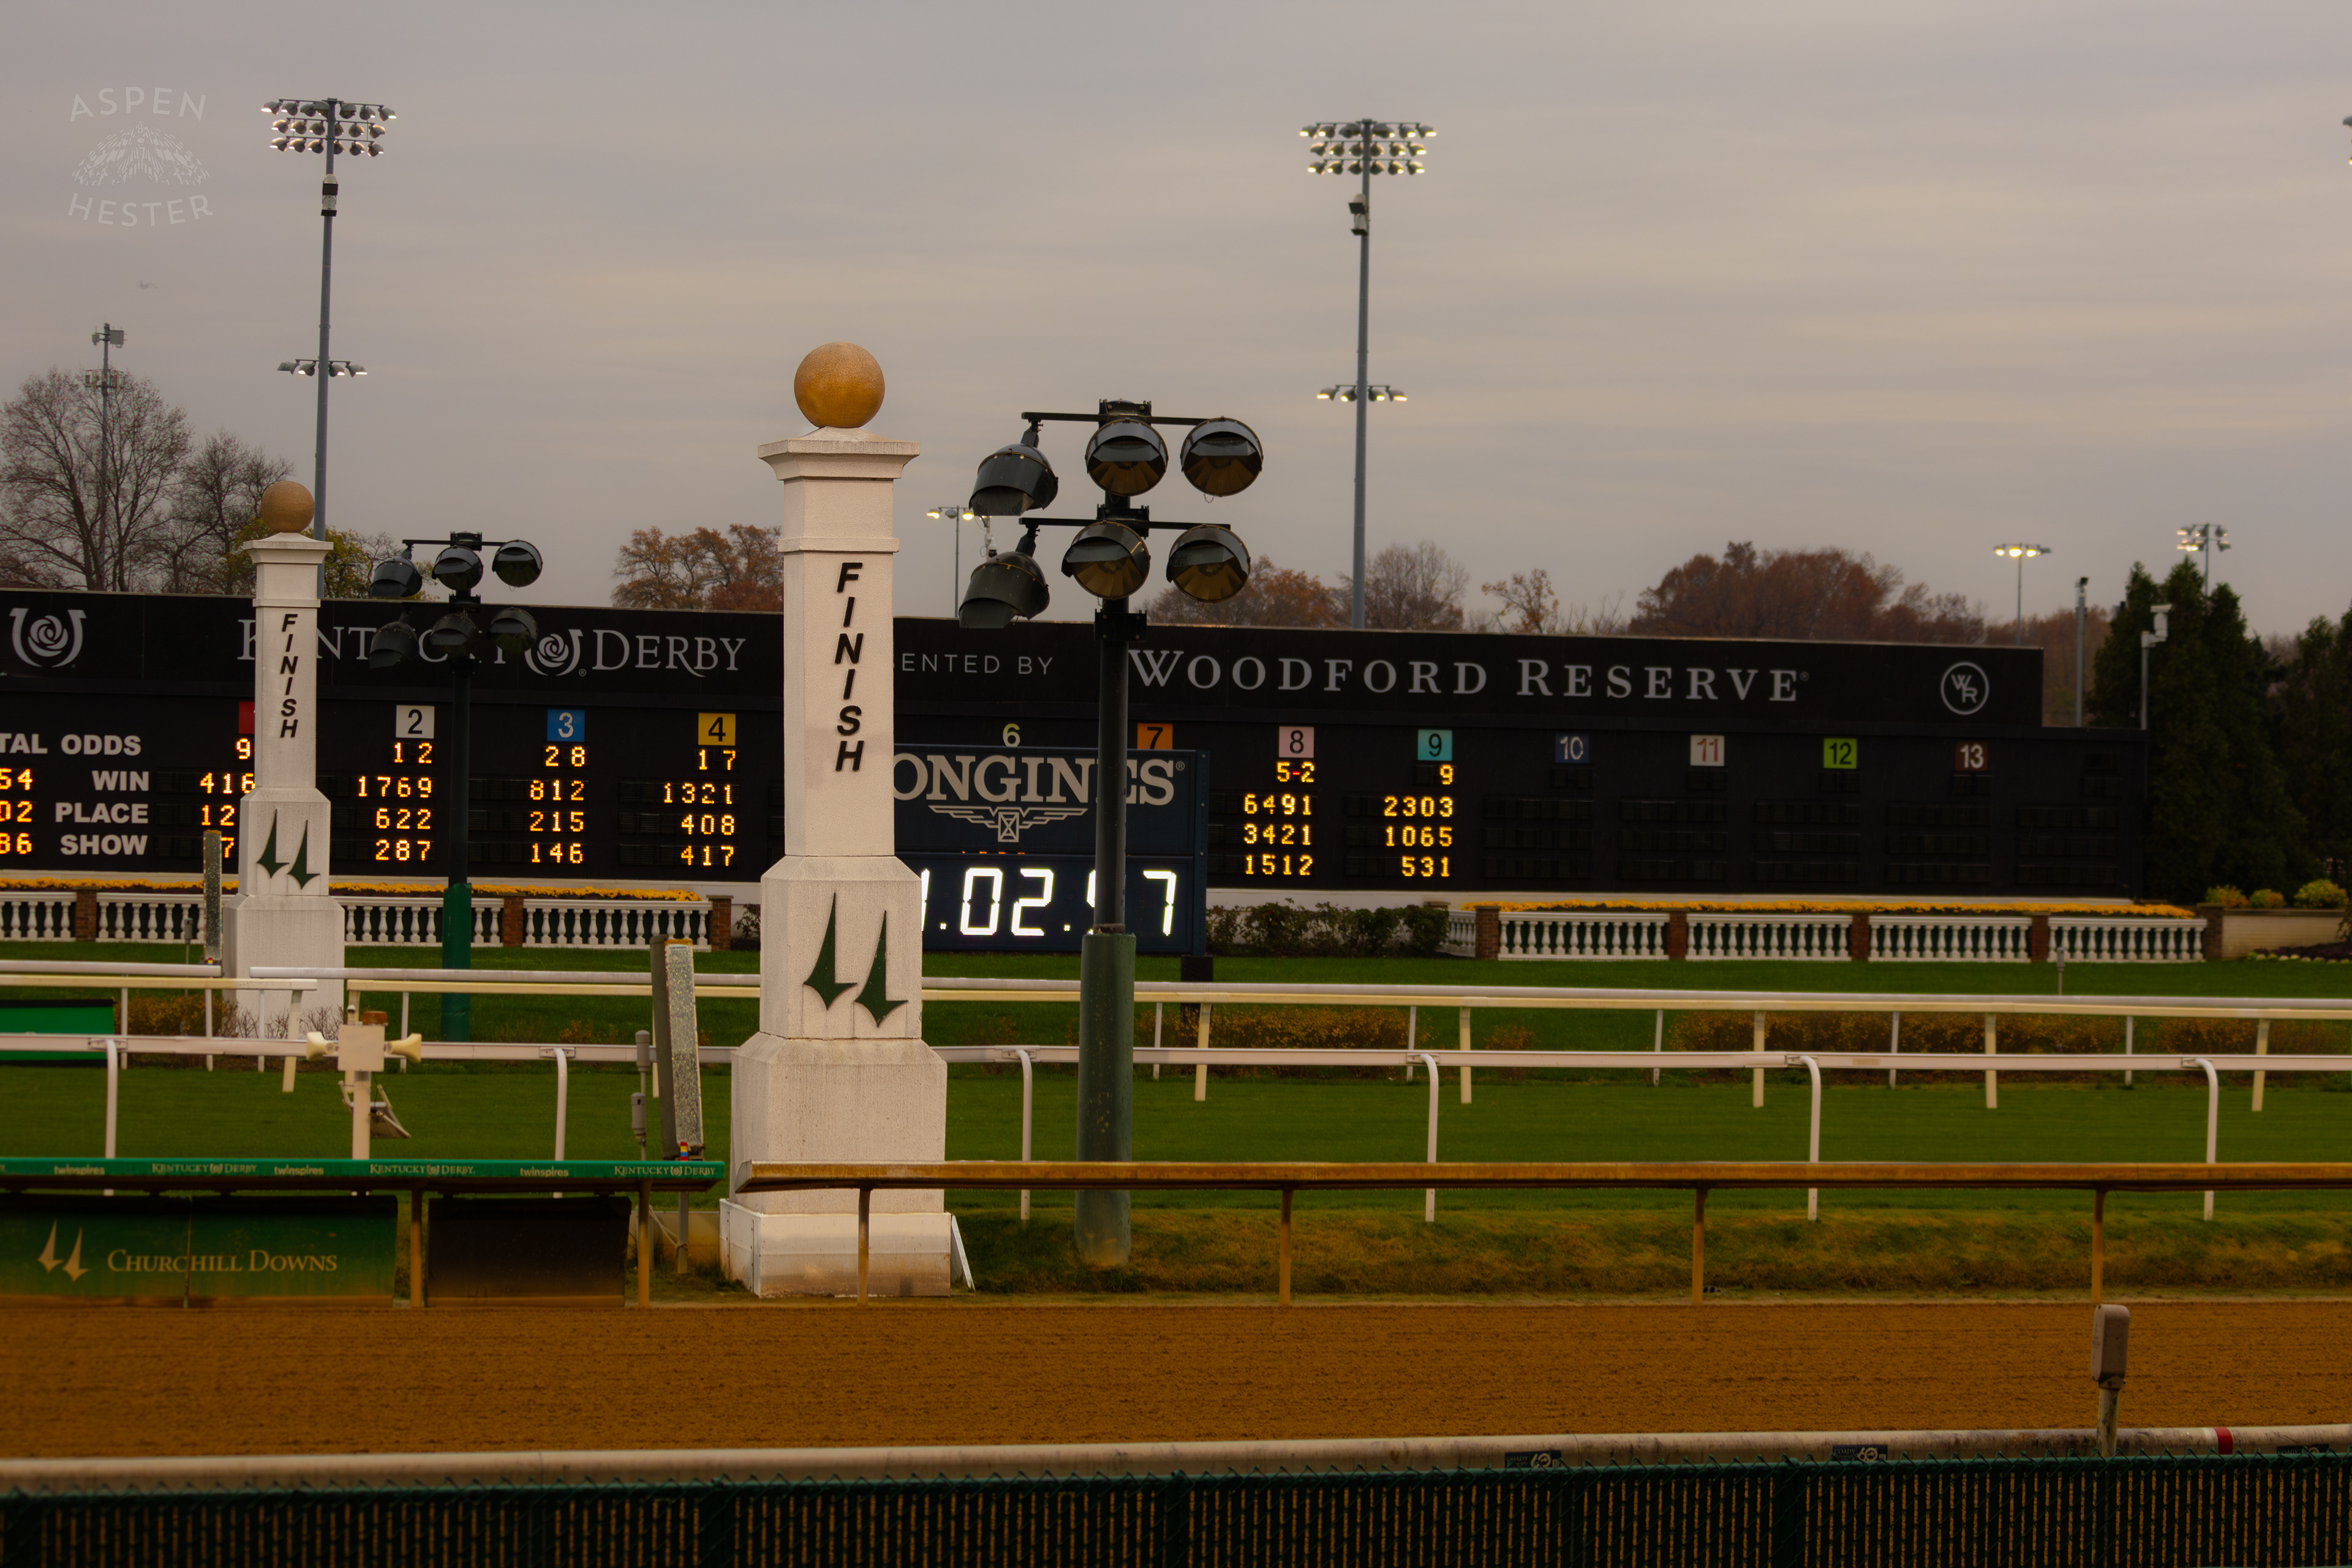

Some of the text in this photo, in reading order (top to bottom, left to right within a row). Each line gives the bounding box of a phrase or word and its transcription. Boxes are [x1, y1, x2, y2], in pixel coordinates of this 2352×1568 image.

[279, 613, 298, 738] FINISH
[592, 629, 746, 677] DERBY
[894, 653, 1000, 673] ENTED
[1018, 657, 1053, 675] BY
[1128, 649, 1487, 694] WOODFORD
[1517, 659, 1797, 701] RESERVE
[835, 562, 865, 772] FINISH
[407, 709, 423, 734] 2
[557, 712, 575, 738] 3
[707, 717, 726, 742] 4
[61, 734, 141, 756] ODDS
[1003, 723, 1020, 747] 6
[1147, 726, 1164, 749] 7
[1289, 729, 1305, 754] 8
[1428, 733, 1443, 757] 9
[236, 738, 251, 760] 9
[1560, 736, 1584, 760] 10
[1697, 738, 1719, 762] 11
[1829, 742, 1852, 765] 12
[1960, 744, 1984, 769] 13
[92, 770, 149, 791] WIN
[894, 753, 1174, 806] ONGINS
[1439, 764, 1453, 785] 9
[358, 776, 432, 798] 1769
[529, 780, 584, 801] 812
[663, 783, 733, 804] 1321
[55, 802, 149, 824] PLACE
[1245, 793, 1311, 815] 6491
[1384, 796, 1453, 818] 2303
[202, 805, 235, 826] 12
[375, 807, 431, 830] 622
[529, 811, 584, 832] 215
[680, 813, 735, 835] 408
[60, 834, 148, 855] SHOW
[1244, 823, 1311, 846] 3421
[1385, 826, 1452, 847] 1065
[375, 839, 431, 861] 287
[531, 843, 583, 864] 146
[681, 845, 734, 867] 417
[1245, 854, 1313, 876] 1512
[1401, 856, 1450, 877] 531
[54, 1164, 105, 1176] twinspires
[152, 1163, 258, 1174] KENTUCKY DERBY
[274, 1164, 324, 1177] twinspires
[370, 1163, 474, 1175] KENTUCKY DERBY
[519, 1166, 569, 1178] twinspires
[614, 1164, 716, 1176] KENTUCKY DERBY
[107, 1249, 337, 1272] CHURCHILL DOWNS
